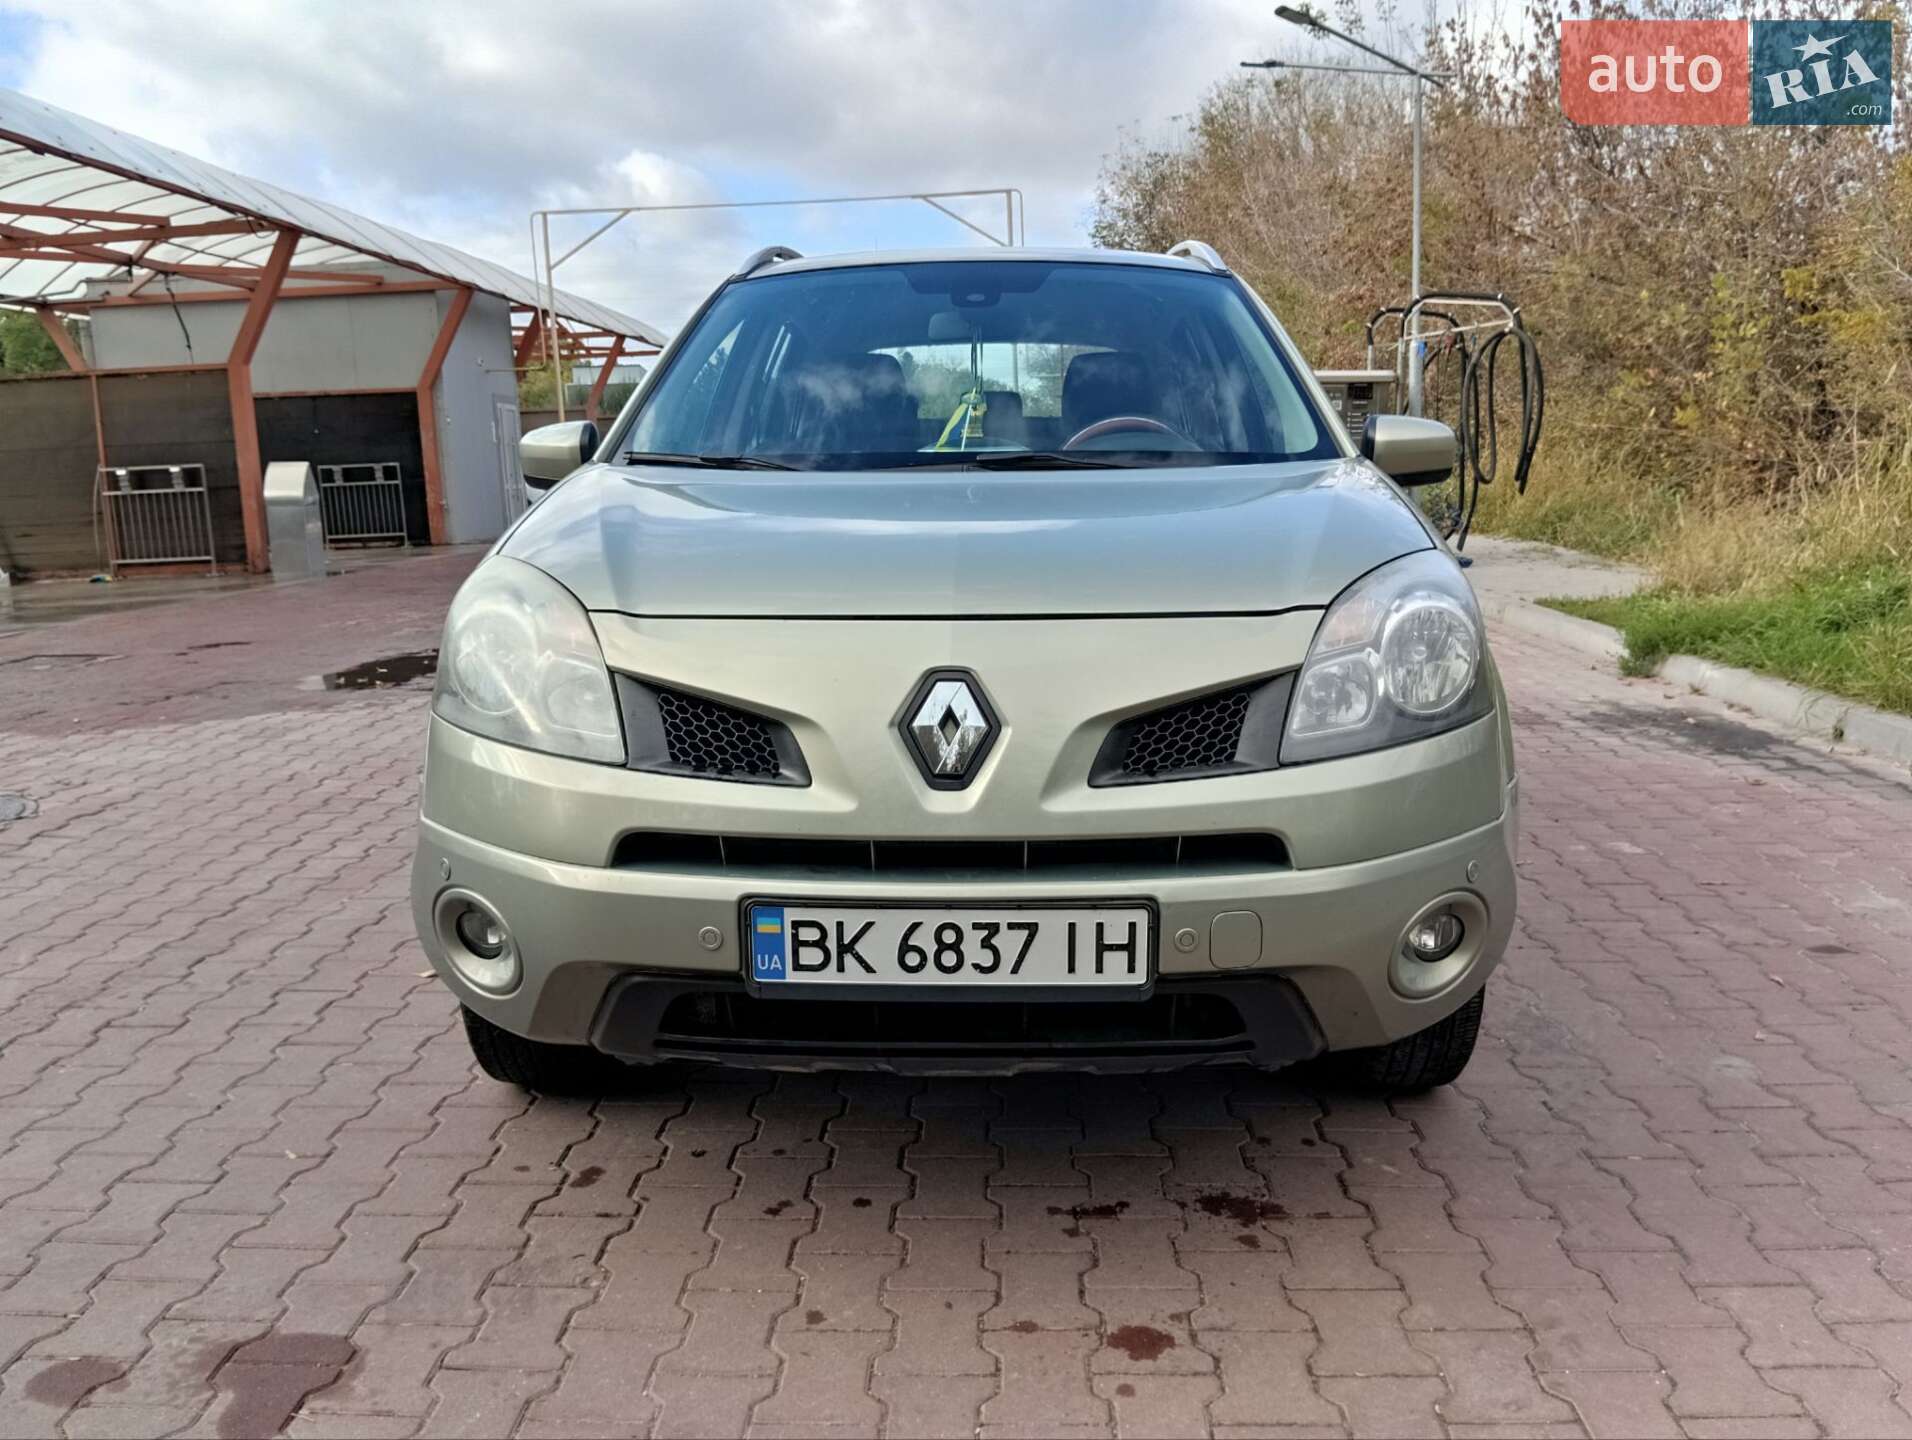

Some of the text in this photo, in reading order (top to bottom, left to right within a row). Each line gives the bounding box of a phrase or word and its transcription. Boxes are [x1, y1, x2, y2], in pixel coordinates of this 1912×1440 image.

[757, 954, 783, 971] UA
[791, 919, 1137, 975] BK 6837 IH
